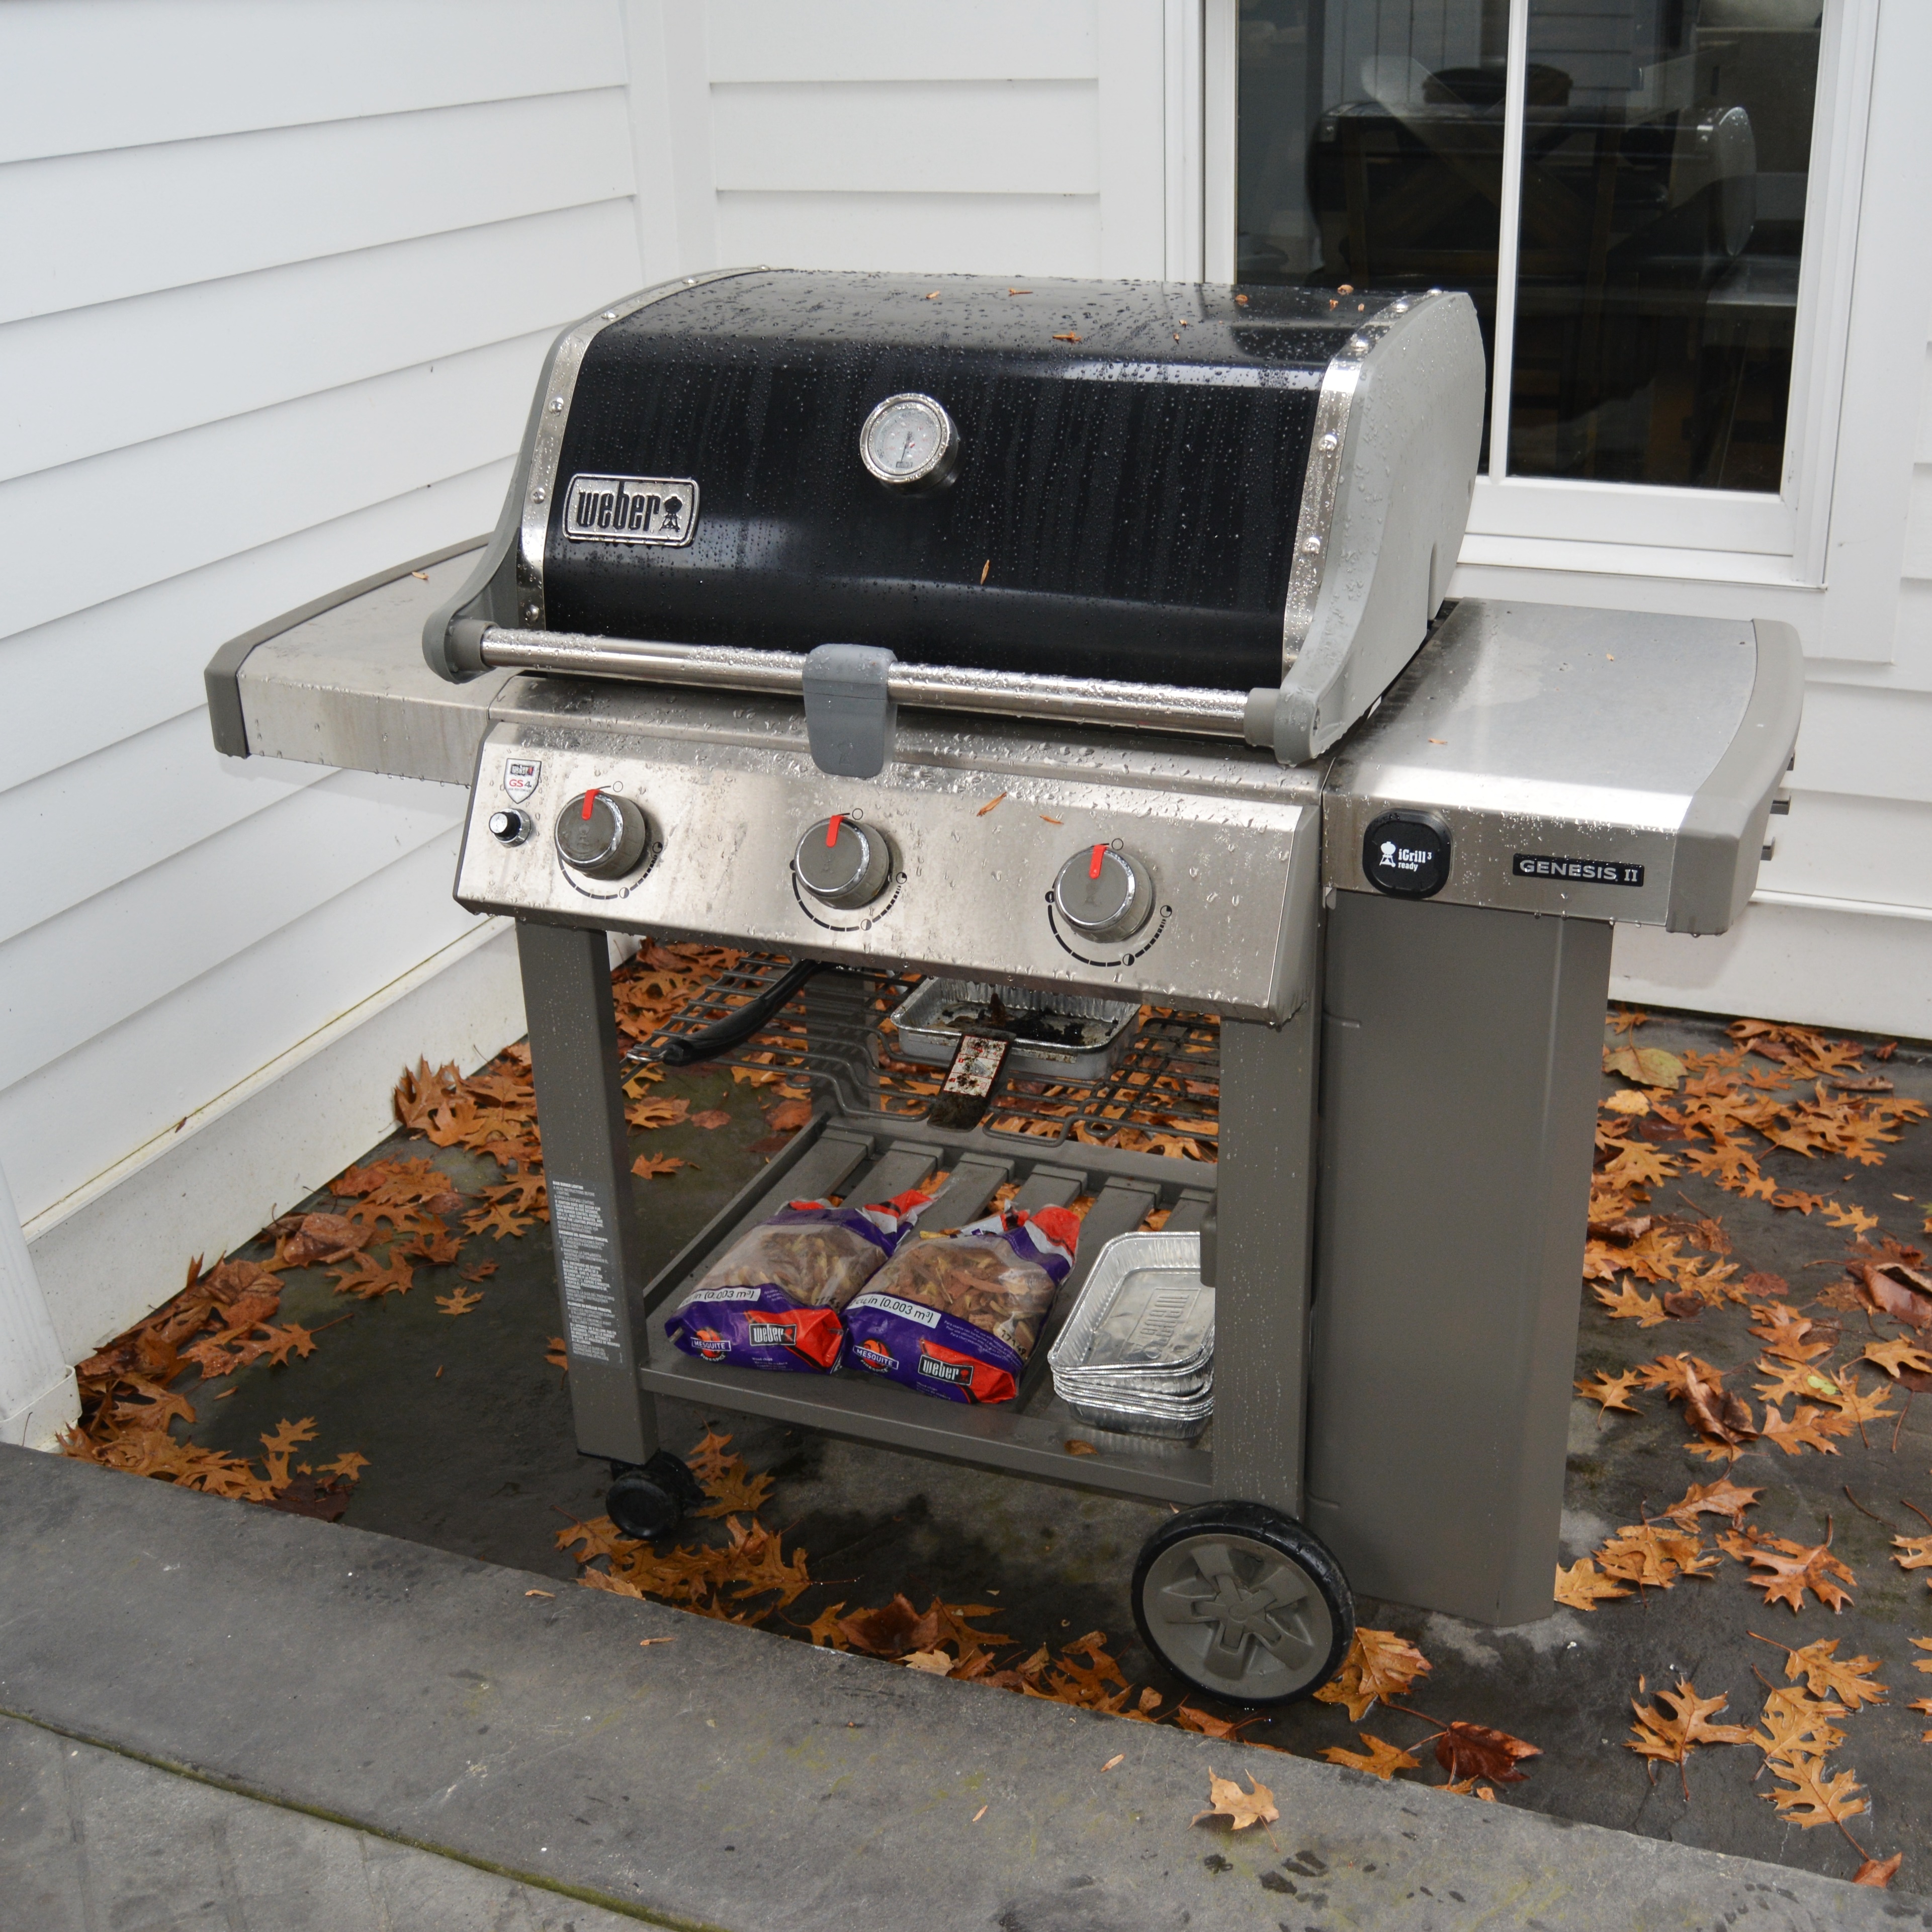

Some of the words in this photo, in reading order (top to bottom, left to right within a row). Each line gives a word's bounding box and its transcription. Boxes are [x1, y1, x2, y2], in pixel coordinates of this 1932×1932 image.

[577, 481, 661, 531] weber
[1398, 848, 1426, 863] iGrill
[1398, 862, 1418, 872] ready
[1520, 859, 1617, 880] GENESIS
[1624, 869, 1638, 882] II
[705, 1290, 734, 1300] (0.003
[868, 1296, 878, 1304] in
[880, 1297, 913, 1315] (0.003
[753, 1324, 784, 1344] weber
[694, 1340, 725, 1349] MESQUITE
[856, 1349, 893, 1366] MESQUITE
[922, 1359, 959, 1380] weber
